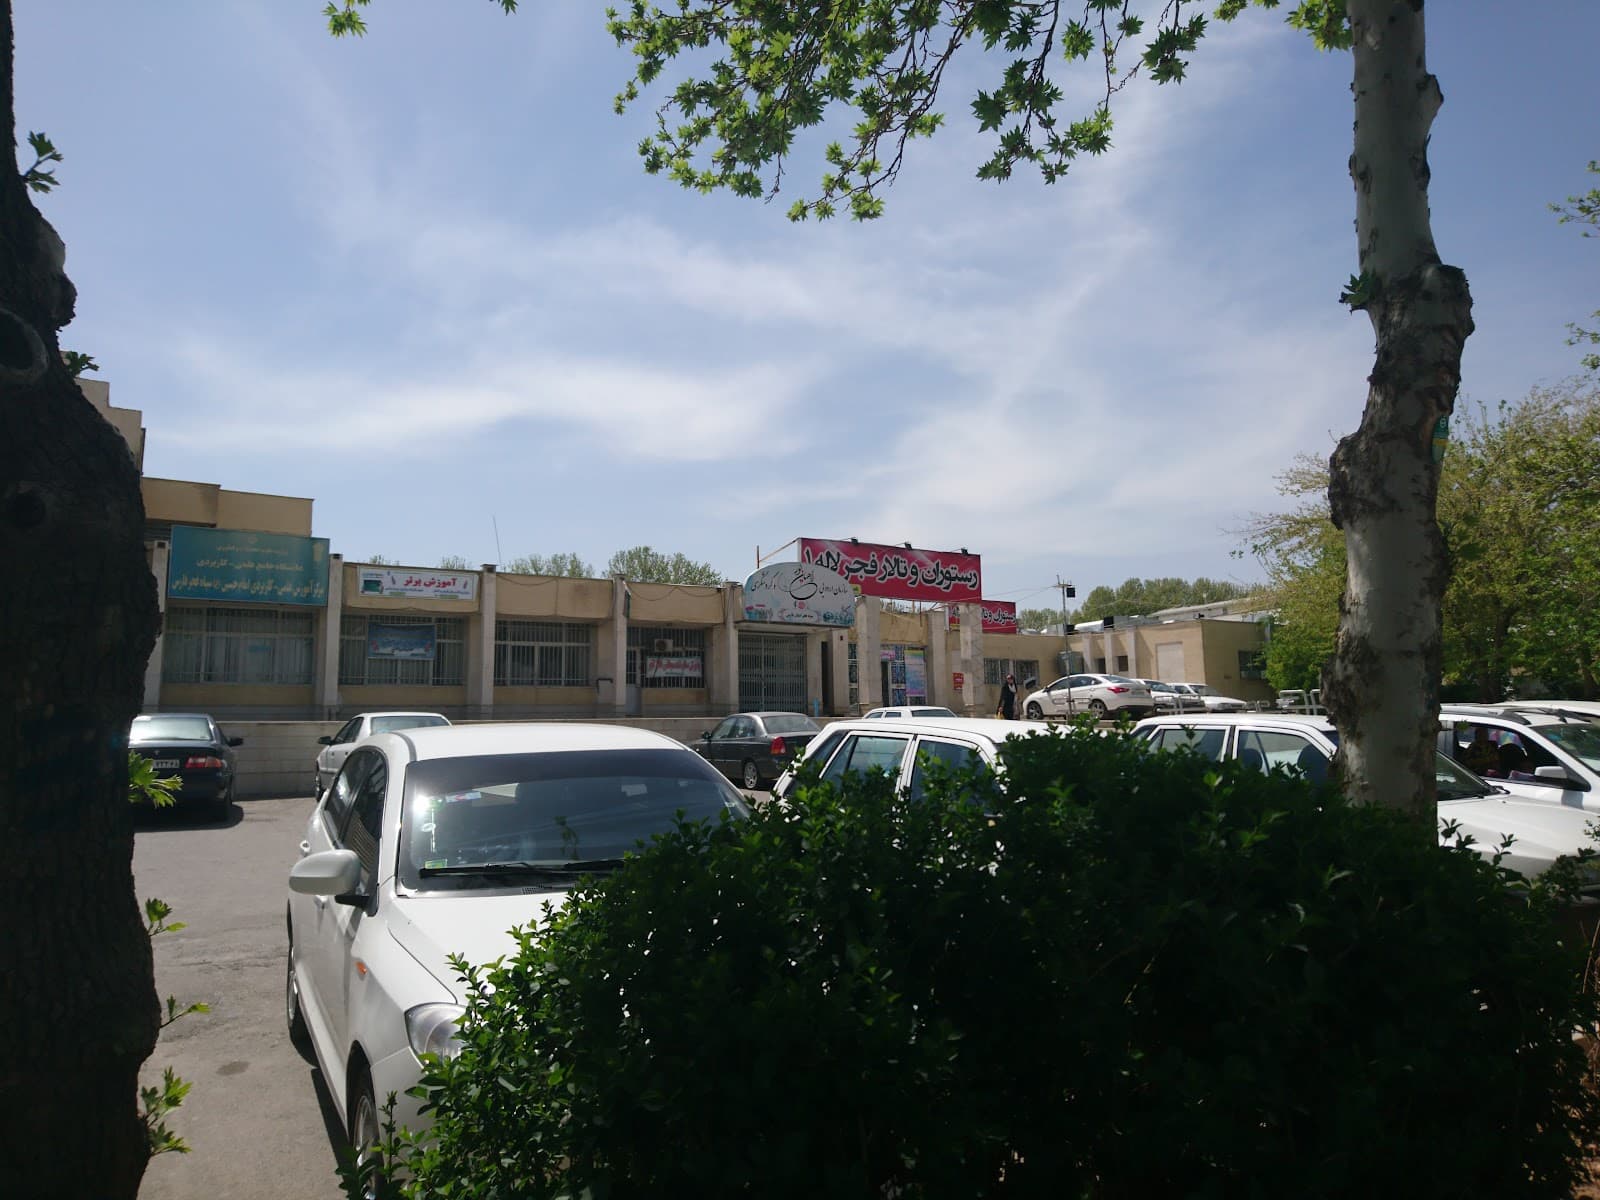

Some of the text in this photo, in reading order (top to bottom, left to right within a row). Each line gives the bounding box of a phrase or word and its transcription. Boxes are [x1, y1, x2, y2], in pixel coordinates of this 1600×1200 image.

[844, 553, 879, 580] فجر
[877, 555, 908, 582] تالار
[908, 561, 919, 586] و
[921, 561, 978, 591] رستوران
[424, 577, 457, 589] آموزش
